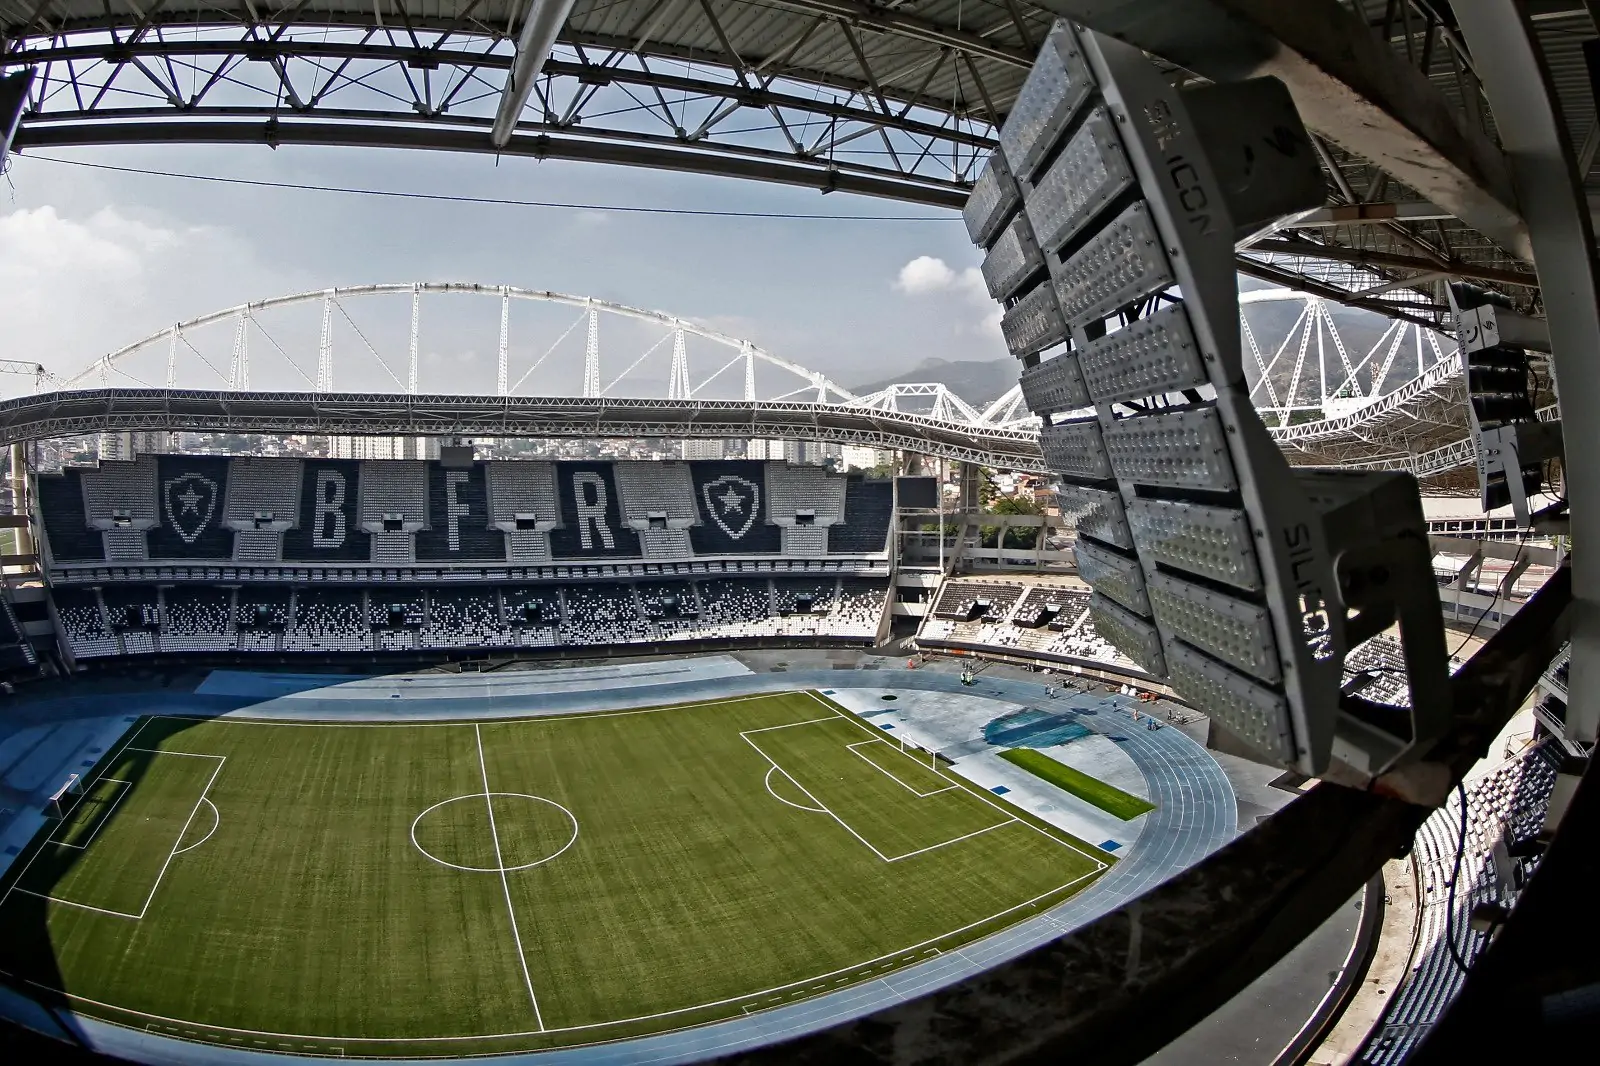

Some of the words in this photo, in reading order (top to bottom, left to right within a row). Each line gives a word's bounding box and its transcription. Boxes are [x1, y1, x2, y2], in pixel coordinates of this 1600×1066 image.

[1143, 98, 1217, 236] SILICON
[1455, 314, 1466, 355] SILICON
[1476, 433, 1485, 475] SILICON
[313, 470, 346, 548] B
[446, 471, 470, 551] F
[573, 471, 615, 549] R
[1283, 523, 1334, 661] SILICON
